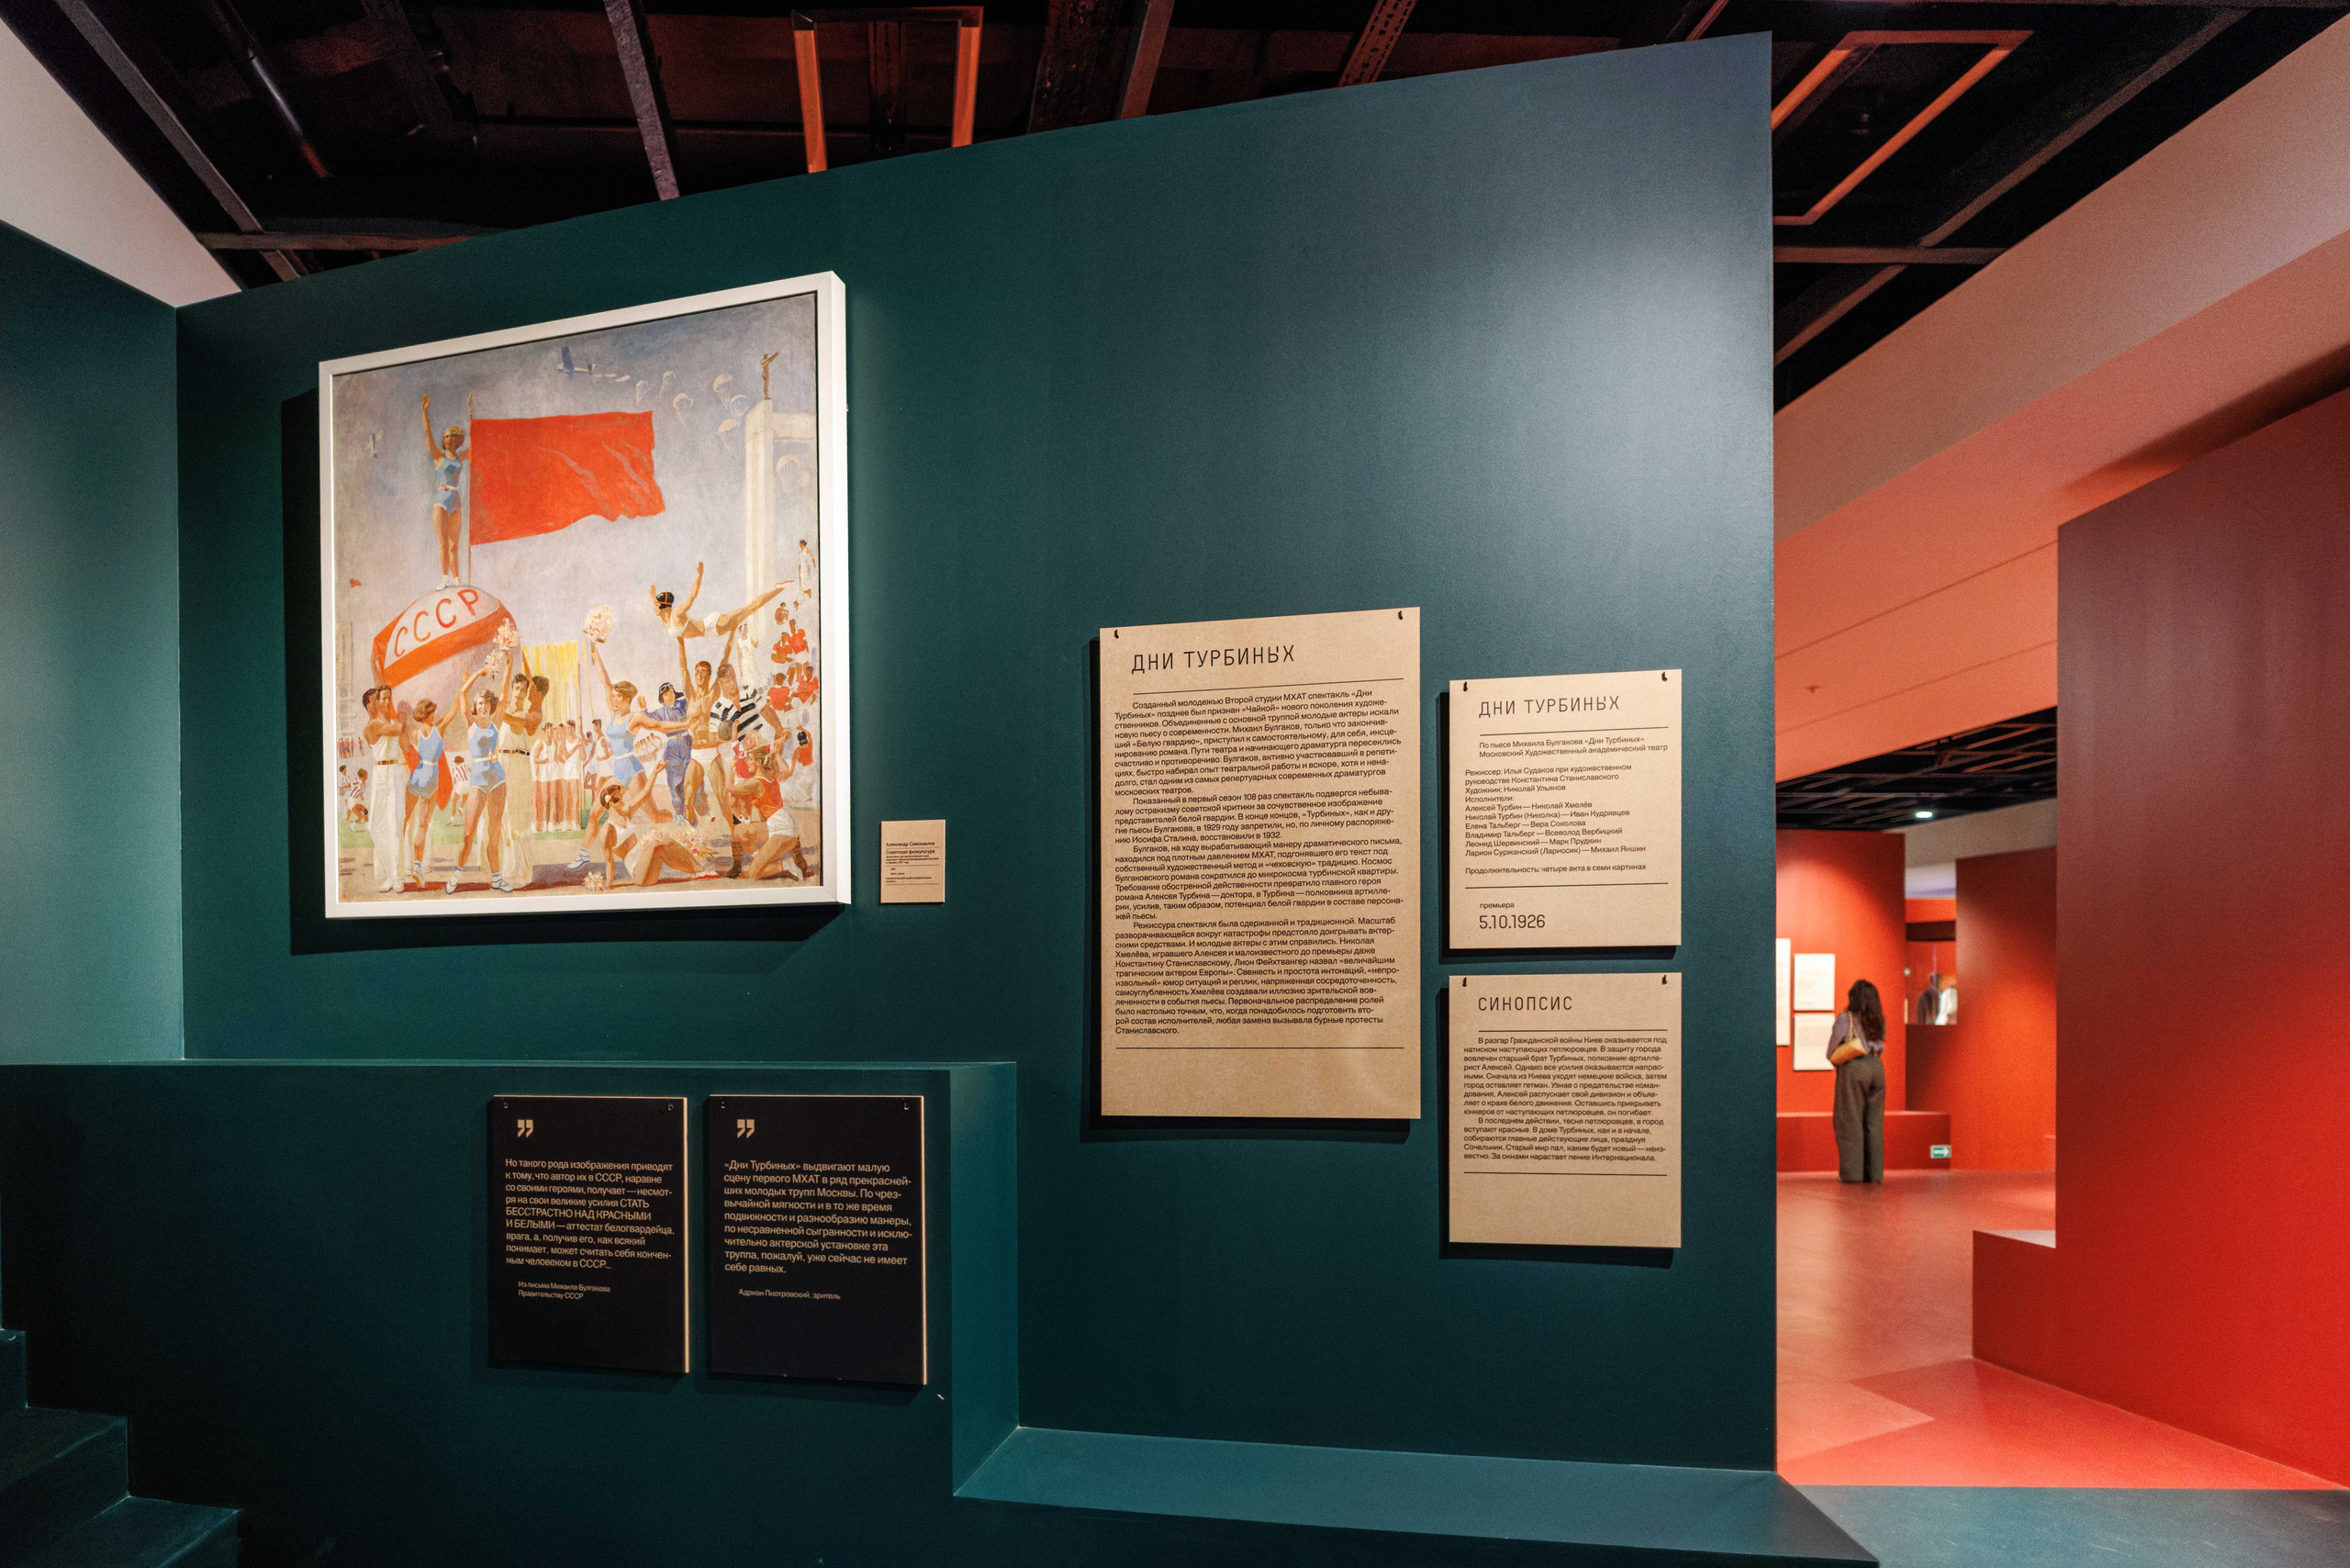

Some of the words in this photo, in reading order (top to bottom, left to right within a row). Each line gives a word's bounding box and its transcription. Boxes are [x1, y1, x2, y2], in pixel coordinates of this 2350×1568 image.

[394, 588, 479, 657] СССР
[1131, 652, 1173, 673] ДНИ
[1183, 645, 1294, 668] ТУРБИНЫХ
[1132, 700, 1176, 709] Созданный
[1178, 699, 1224, 707] молодежью
[1225, 695, 1253, 705] Второй
[1283, 692, 1307, 701] МХАТ
[1351, 689, 1372, 698] «Дни
[1478, 700, 1515, 718] ДНИ
[1524, 696, 1619, 713] ТУРБИНЫХ
[1605, 736, 1644, 745] Турбиных»
[1479, 749, 1523, 758] Московский
[1525, 747, 1587, 757] Художественный
[1588, 744, 1646, 754] академический
[1523, 767, 1554, 775] Судаков
[1570, 765, 1632, 773] художественном
[1465, 778, 1510, 786] руководстве
[1133, 796, 1181, 805] Показанный
[1188, 794, 1217, 803] первый
[1346, 819, 1394, 827] распоряже-
[1465, 867, 1540, 875] Продолжительность:
[1479, 914, 1545, 929] 5.10.1926
[1478, 996, 1572, 1011] СИНОПСИС
[1538, 1135, 1589, 1143] действующие
[505, 1158, 517, 1167] Но
[548, 1161, 569, 1170] рода
[570, 1160, 629, 1171] изображения
[631, 1163, 673, 1172] приводят
[724, 1159, 748, 1171] «Дни
[750, 1160, 801, 1171] Турбиных»
[803, 1163, 856, 1172] выдвигают
[858, 1164, 890, 1174] малую
[512, 1172, 534, 1181] тому,
[550, 1174, 575, 1182] автор
[595, 1173, 624, 1183] СССР,
[625, 1176, 662, 1184] наравне
[724, 1174, 751, 1184] сцену
[752, 1175, 791, 1184] первого
[792, 1174, 820, 1183] МХАТ
[829, 1177, 848, 1186] ряд
[849, 1176, 911, 1187] прекрасней-
[506, 1206, 573, 1218] БЕССТРАСТНО
[574, 1210, 595, 1220] НАД
[596, 1210, 651, 1221] КРАСНЫМИ
[724, 1213, 787, 1222] подвижности
[797, 1214, 868, 1225] разнообразию
[870, 1217, 911, 1227] манеры,
[724, 1239, 768, 1247] чительно
[769, 1239, 819, 1250] актерской
[820, 1242, 870, 1251] установке
[525, 1258, 571, 1267] человеком
[724, 1262, 747, 1272] себе
[749, 1264, 786, 1274] равных.
